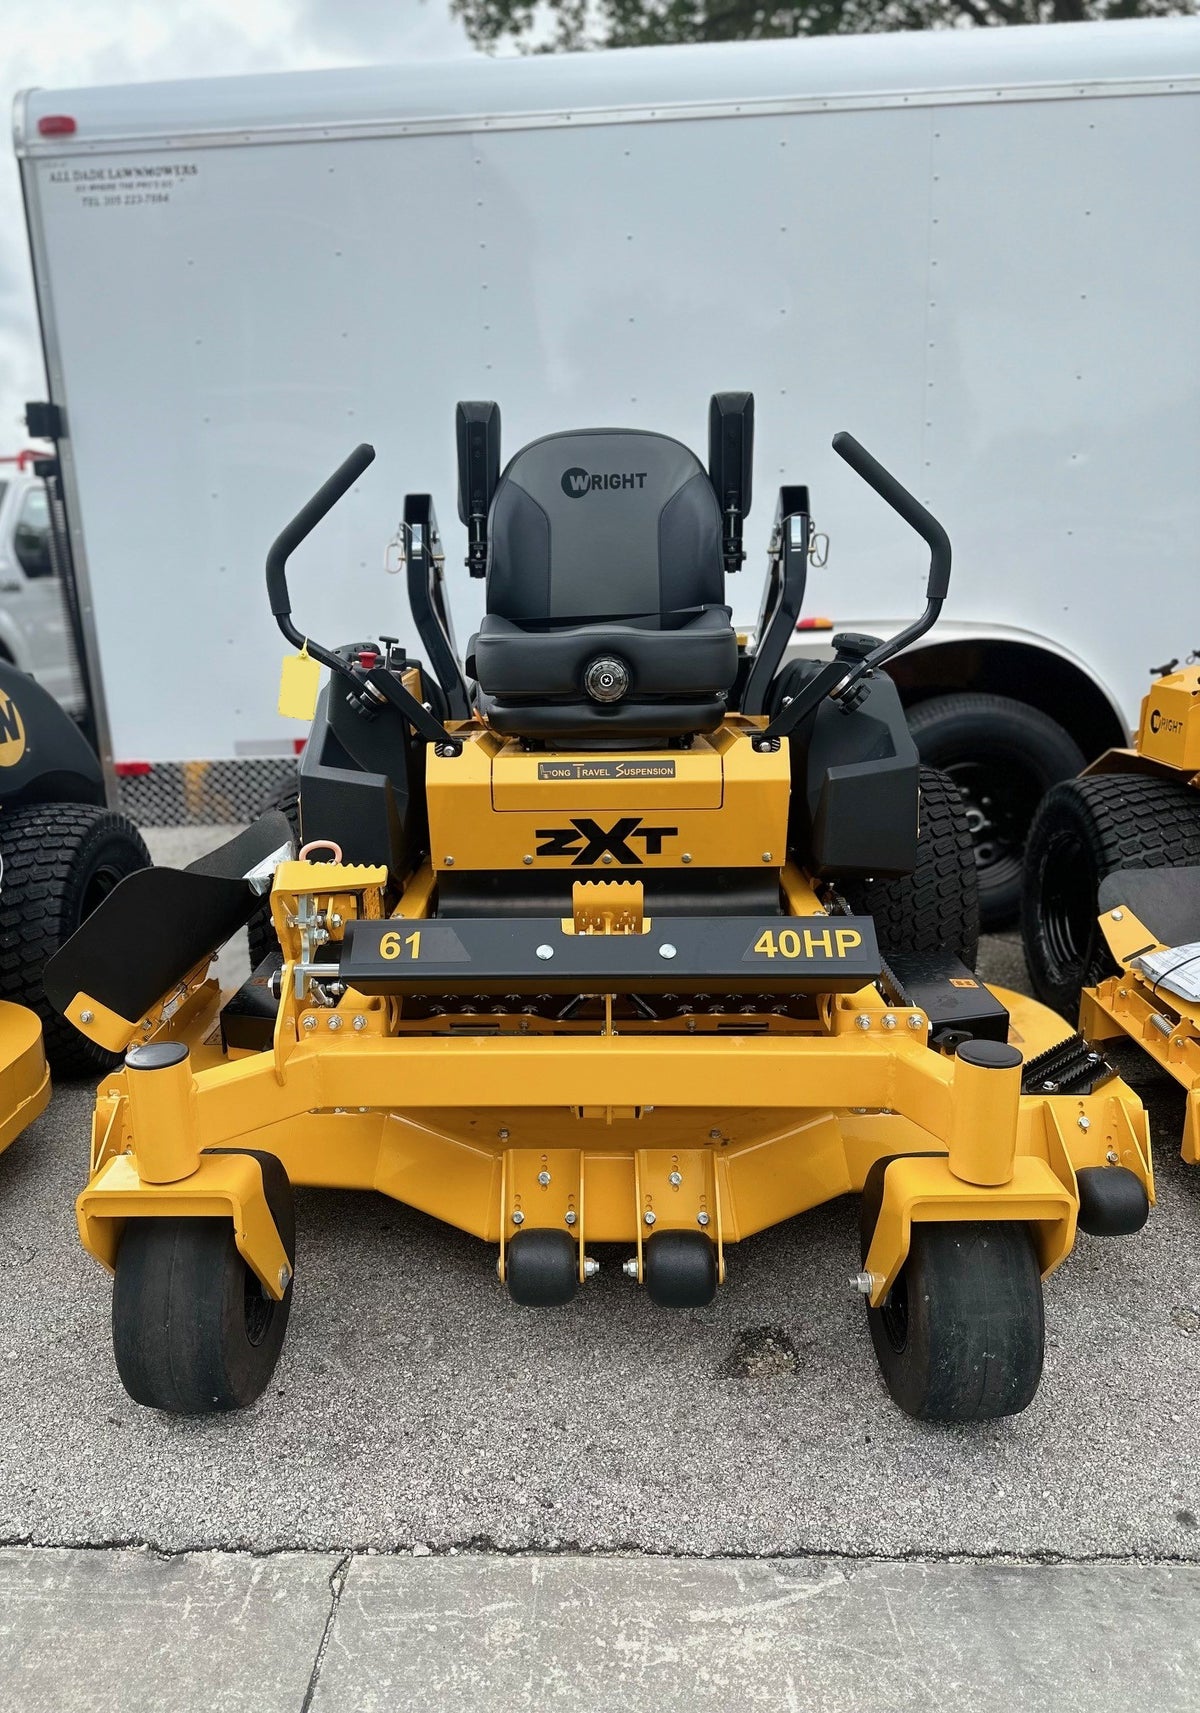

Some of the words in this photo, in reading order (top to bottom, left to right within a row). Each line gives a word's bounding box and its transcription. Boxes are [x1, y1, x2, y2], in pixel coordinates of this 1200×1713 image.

[563, 470, 647, 494] WRIGHT
[1152, 712, 1183, 733] WRIGHT
[615, 763, 674, 778] SUSPENSION
[380, 931, 421, 960] 61
[754, 929, 862, 958] 40HP
